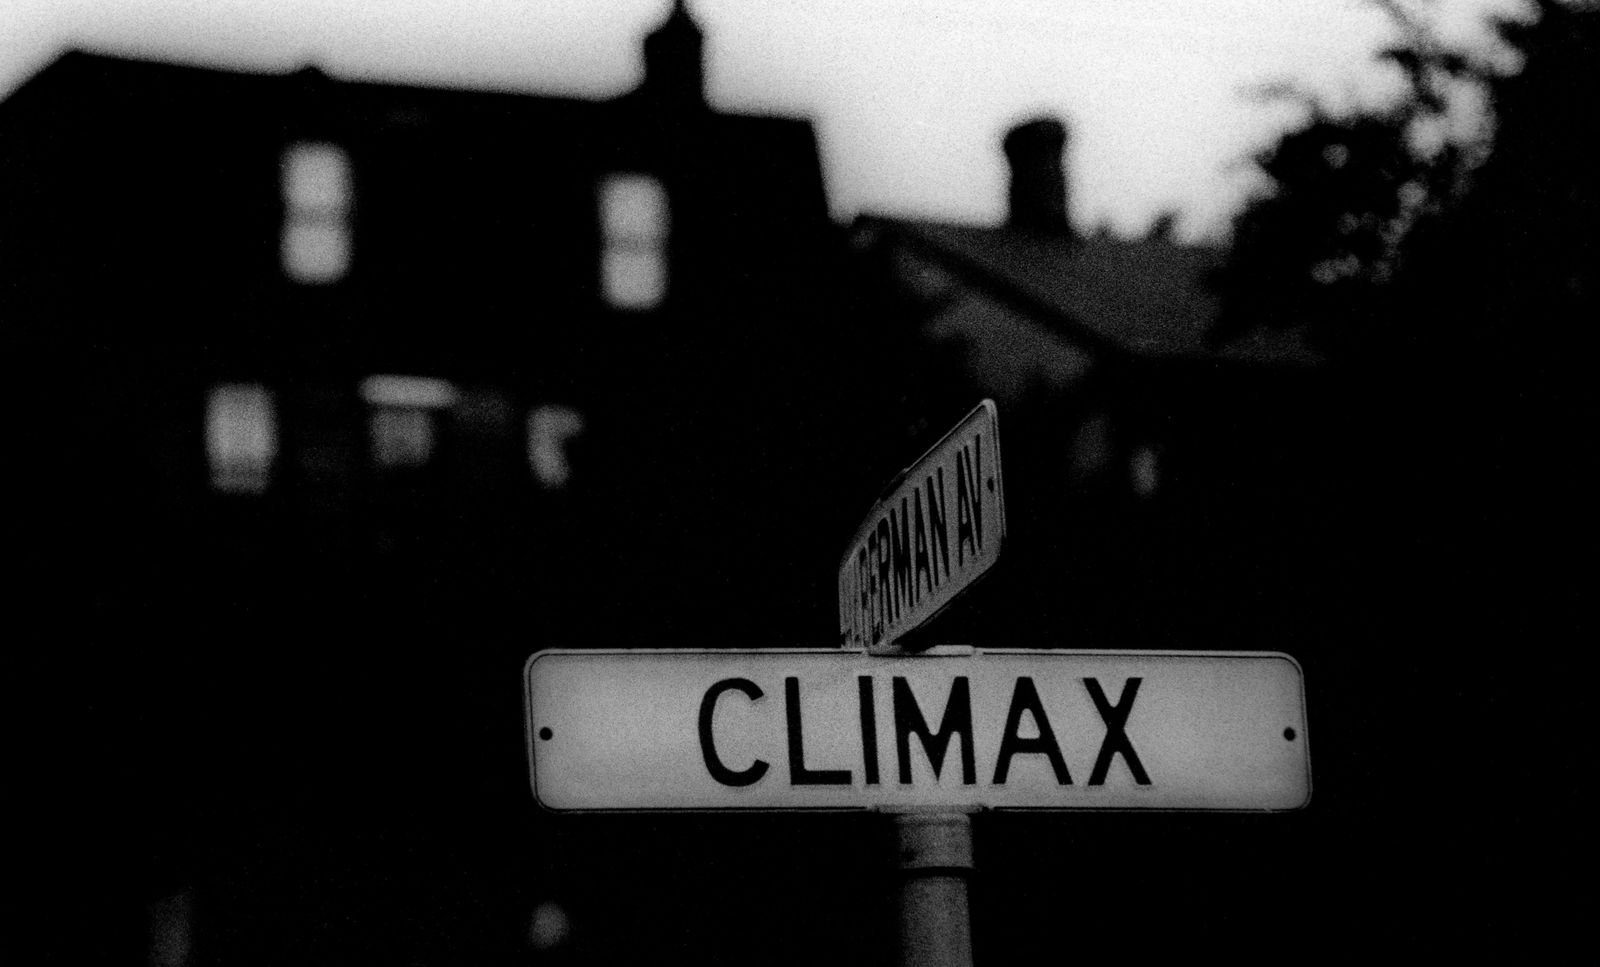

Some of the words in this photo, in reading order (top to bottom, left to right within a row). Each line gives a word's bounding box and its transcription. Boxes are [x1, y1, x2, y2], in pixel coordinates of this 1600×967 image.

[843, 466, 950, 648] BERMAN
[957, 433, 982, 567] AV
[698, 676, 1152, 788] CLIMAX
